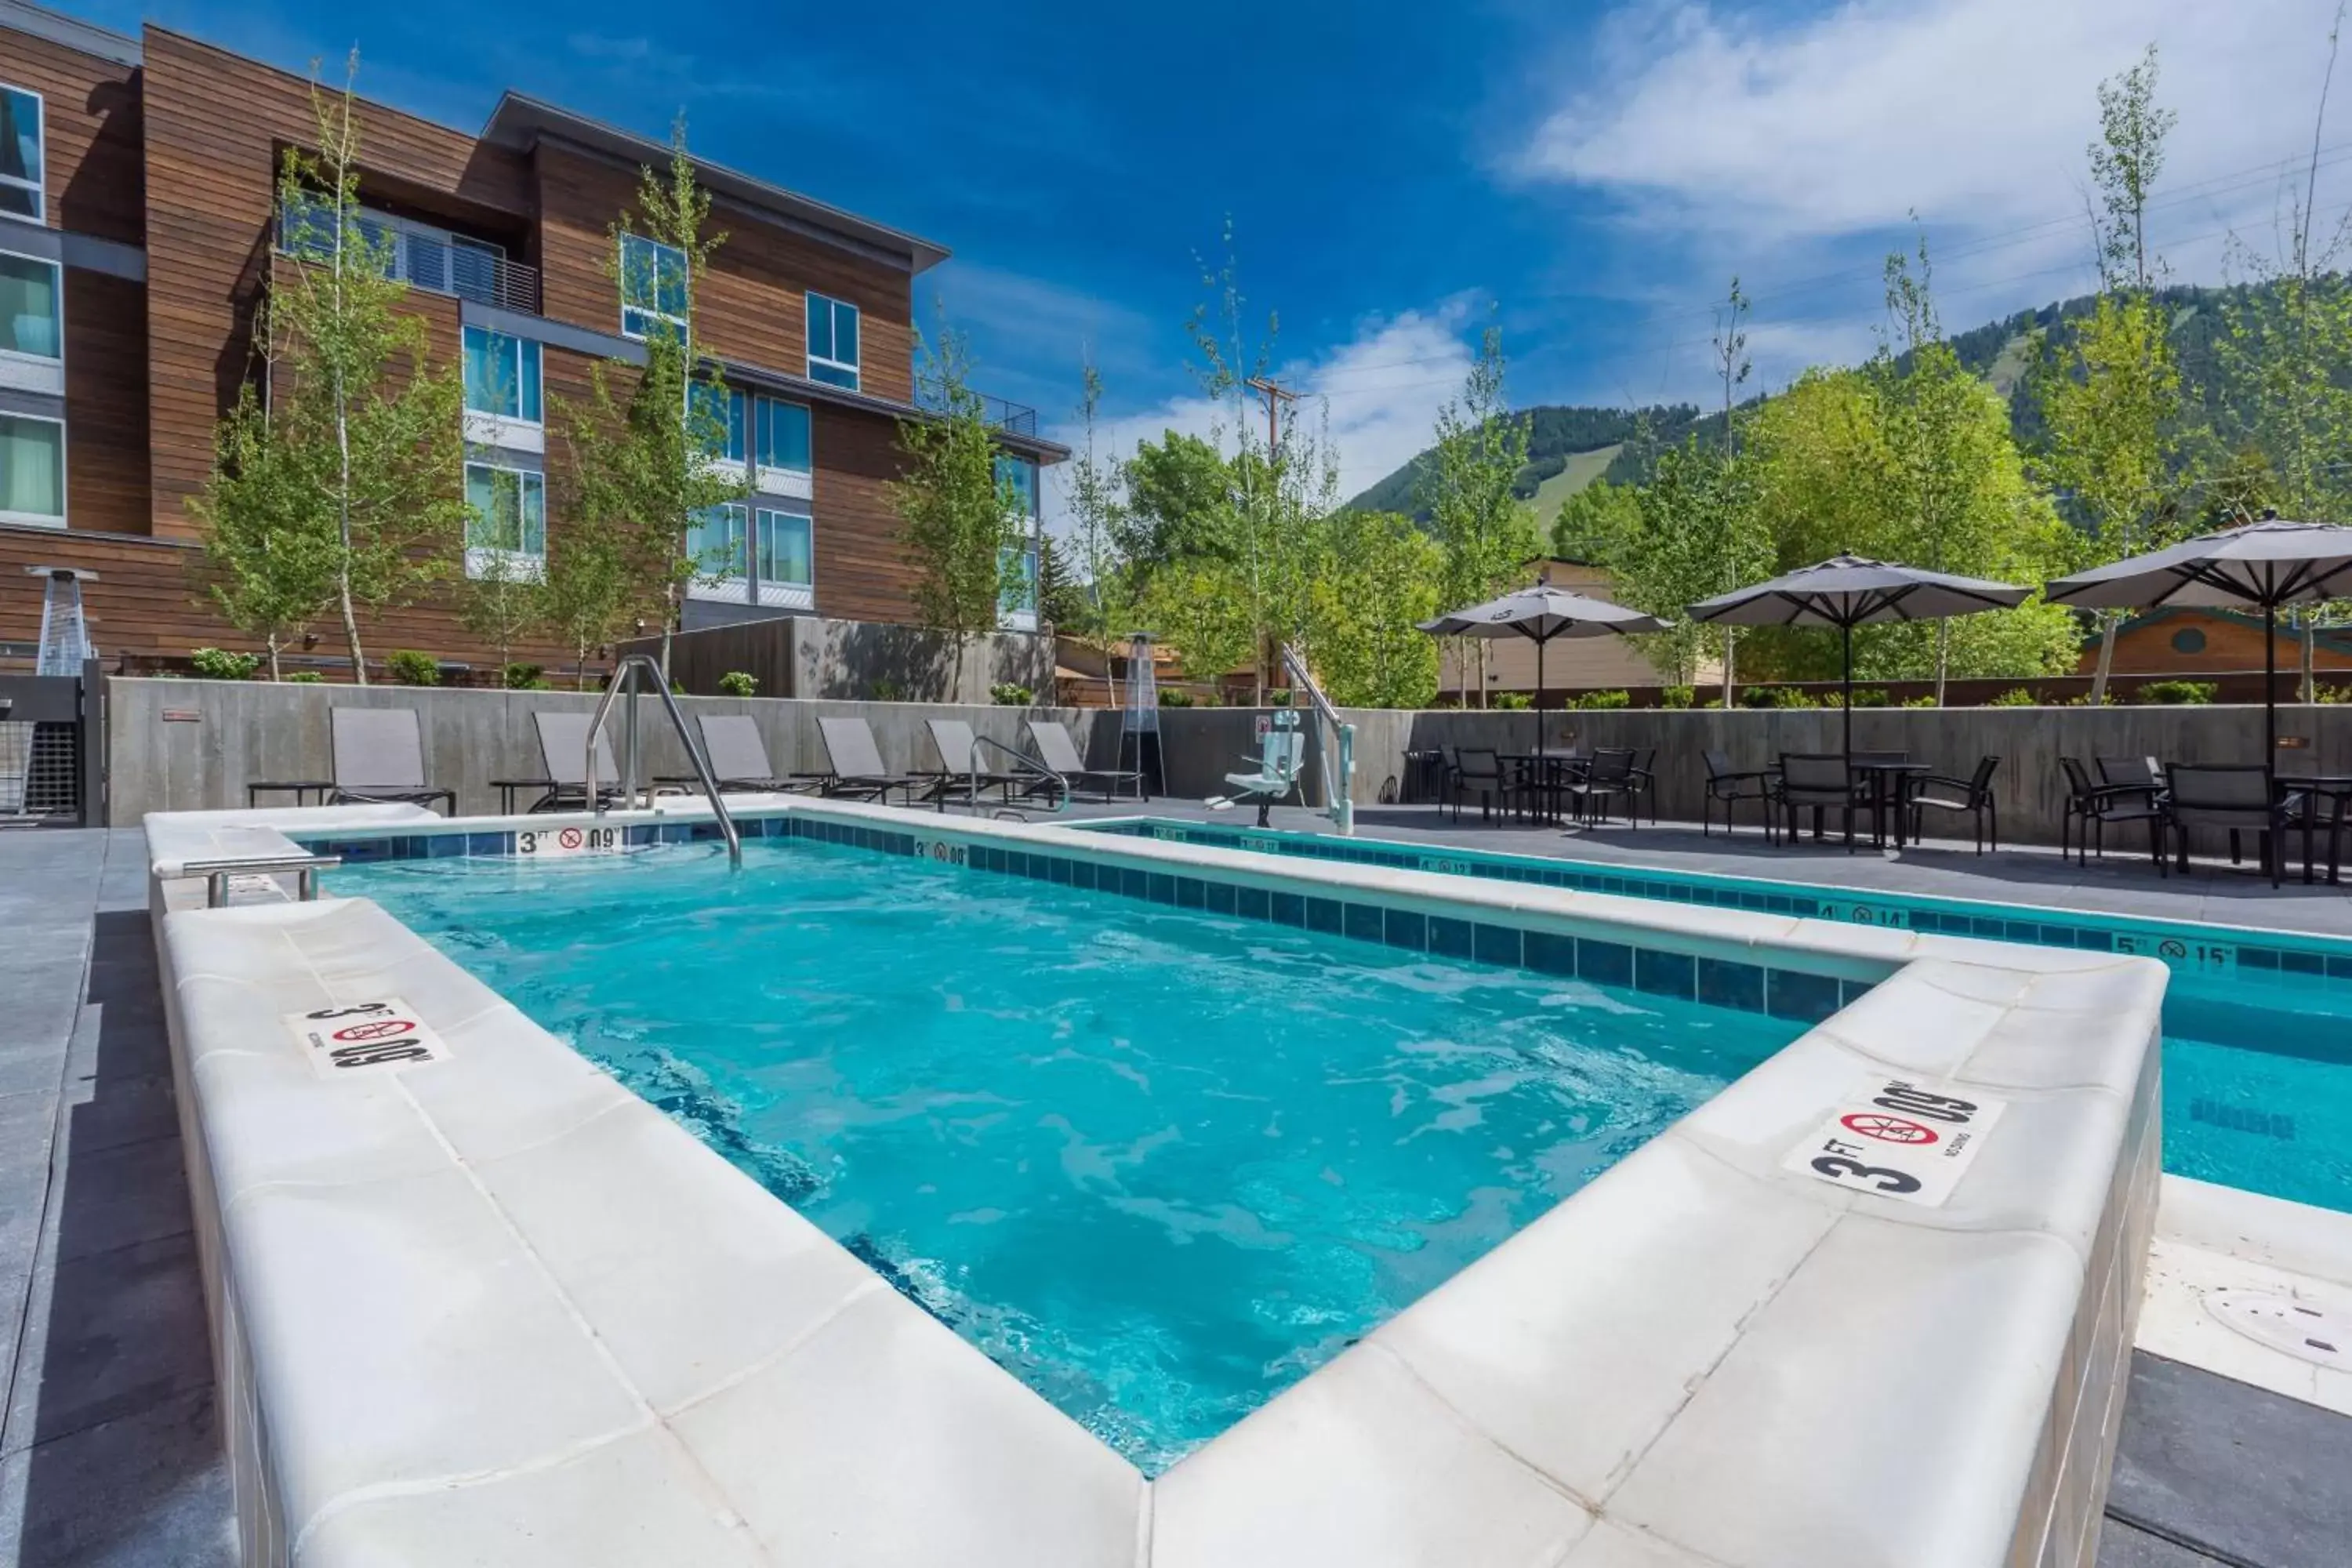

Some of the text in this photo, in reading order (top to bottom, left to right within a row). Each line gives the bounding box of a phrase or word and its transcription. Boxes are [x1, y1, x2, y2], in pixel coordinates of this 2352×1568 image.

[521, 832, 537, 854] 3
[2118, 937, 2134, 953] 5
[307, 1003, 387, 1019] 3
[1811, 1138, 1922, 1193] 3 FT
